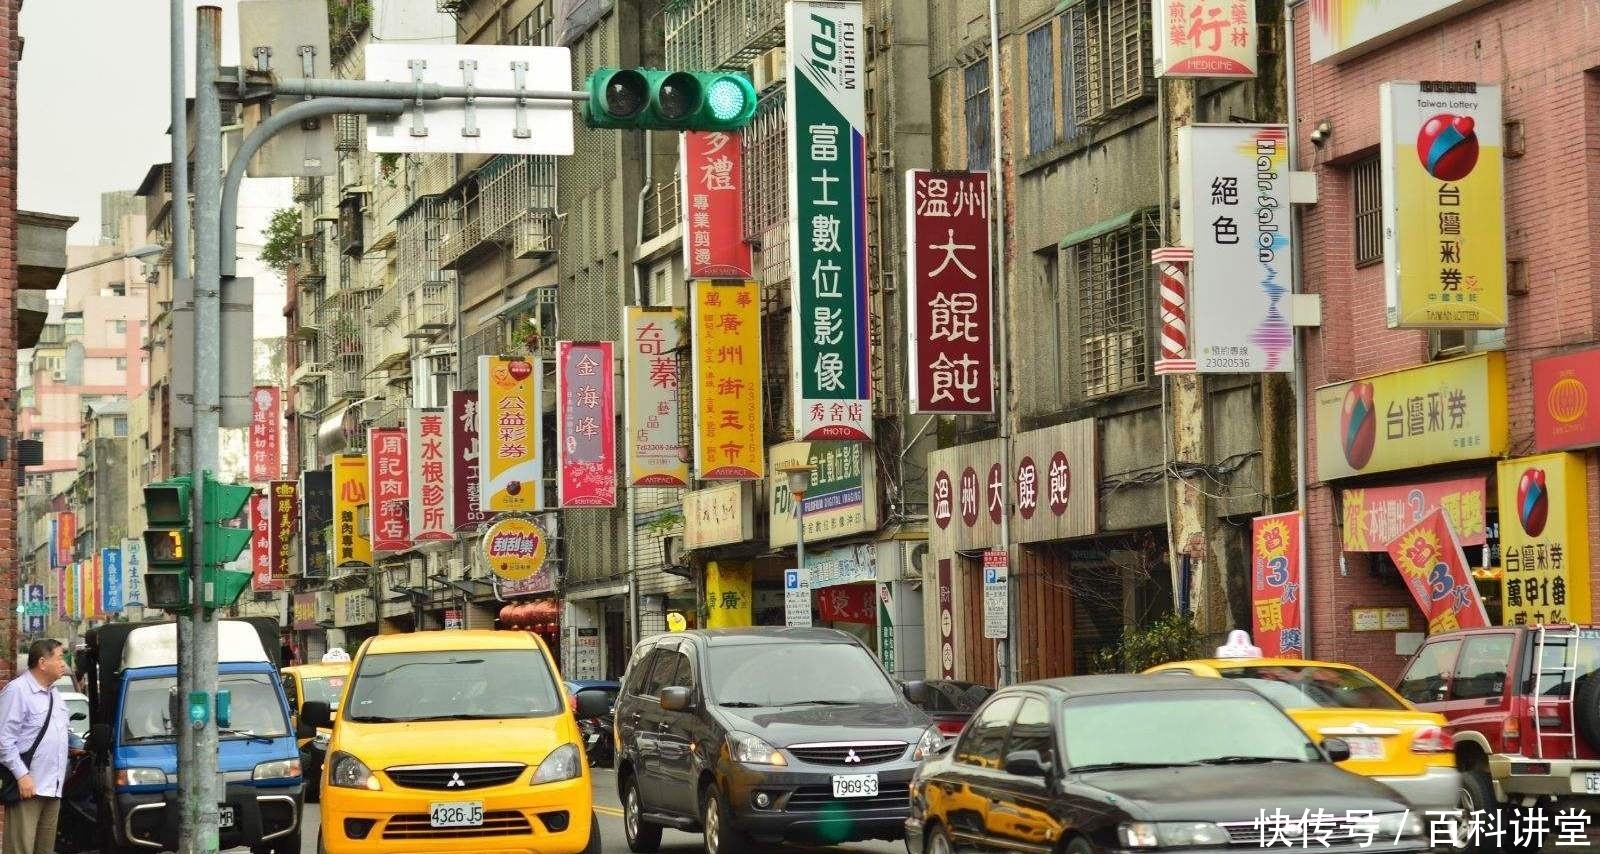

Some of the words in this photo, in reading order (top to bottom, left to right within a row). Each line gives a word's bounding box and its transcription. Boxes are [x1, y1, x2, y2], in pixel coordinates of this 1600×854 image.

[811, 13, 836, 74] FDi
[844, 23, 855, 89] FUJIFILM
[1187, 5, 1230, 51] 行
[1185, 60, 1232, 70] MEDICINE
[1417, 99, 1447, 109] Taiwan
[1450, 99, 1479, 111] Lottery
[699, 132, 736, 190] 多禮
[1257, 140, 1277, 191] Hair
[917, 179, 985, 219] 溫州
[1211, 176, 1239, 245] 絕色
[808, 124, 844, 391] 富士數位影像
[1258, 196, 1278, 262] Salon
[1438, 182, 1462, 291] 台灣彩券
[928, 229, 981, 404] 大餛飩
[715, 313, 744, 464] 廣州街玉市
[1206, 359, 1250, 368] 23020536
[575, 354, 600, 441] 金海峰
[809, 402, 864, 423] 秀舍店
[1387, 389, 1467, 440] 台灣彩券
[498, 396, 526, 459] 公益彩券
[822, 427, 851, 436] PHOTO
[378, 436, 404, 539] 周記肉粥店
[420, 415, 444, 530] 黃水根診所
[935, 460, 1068, 519] 溫州大餛飩
[492, 536, 534, 553] 刮刮樂
[1506, 543, 1562, 573] 台灣彩券
[432, 806, 482, 823] 4326-J5
